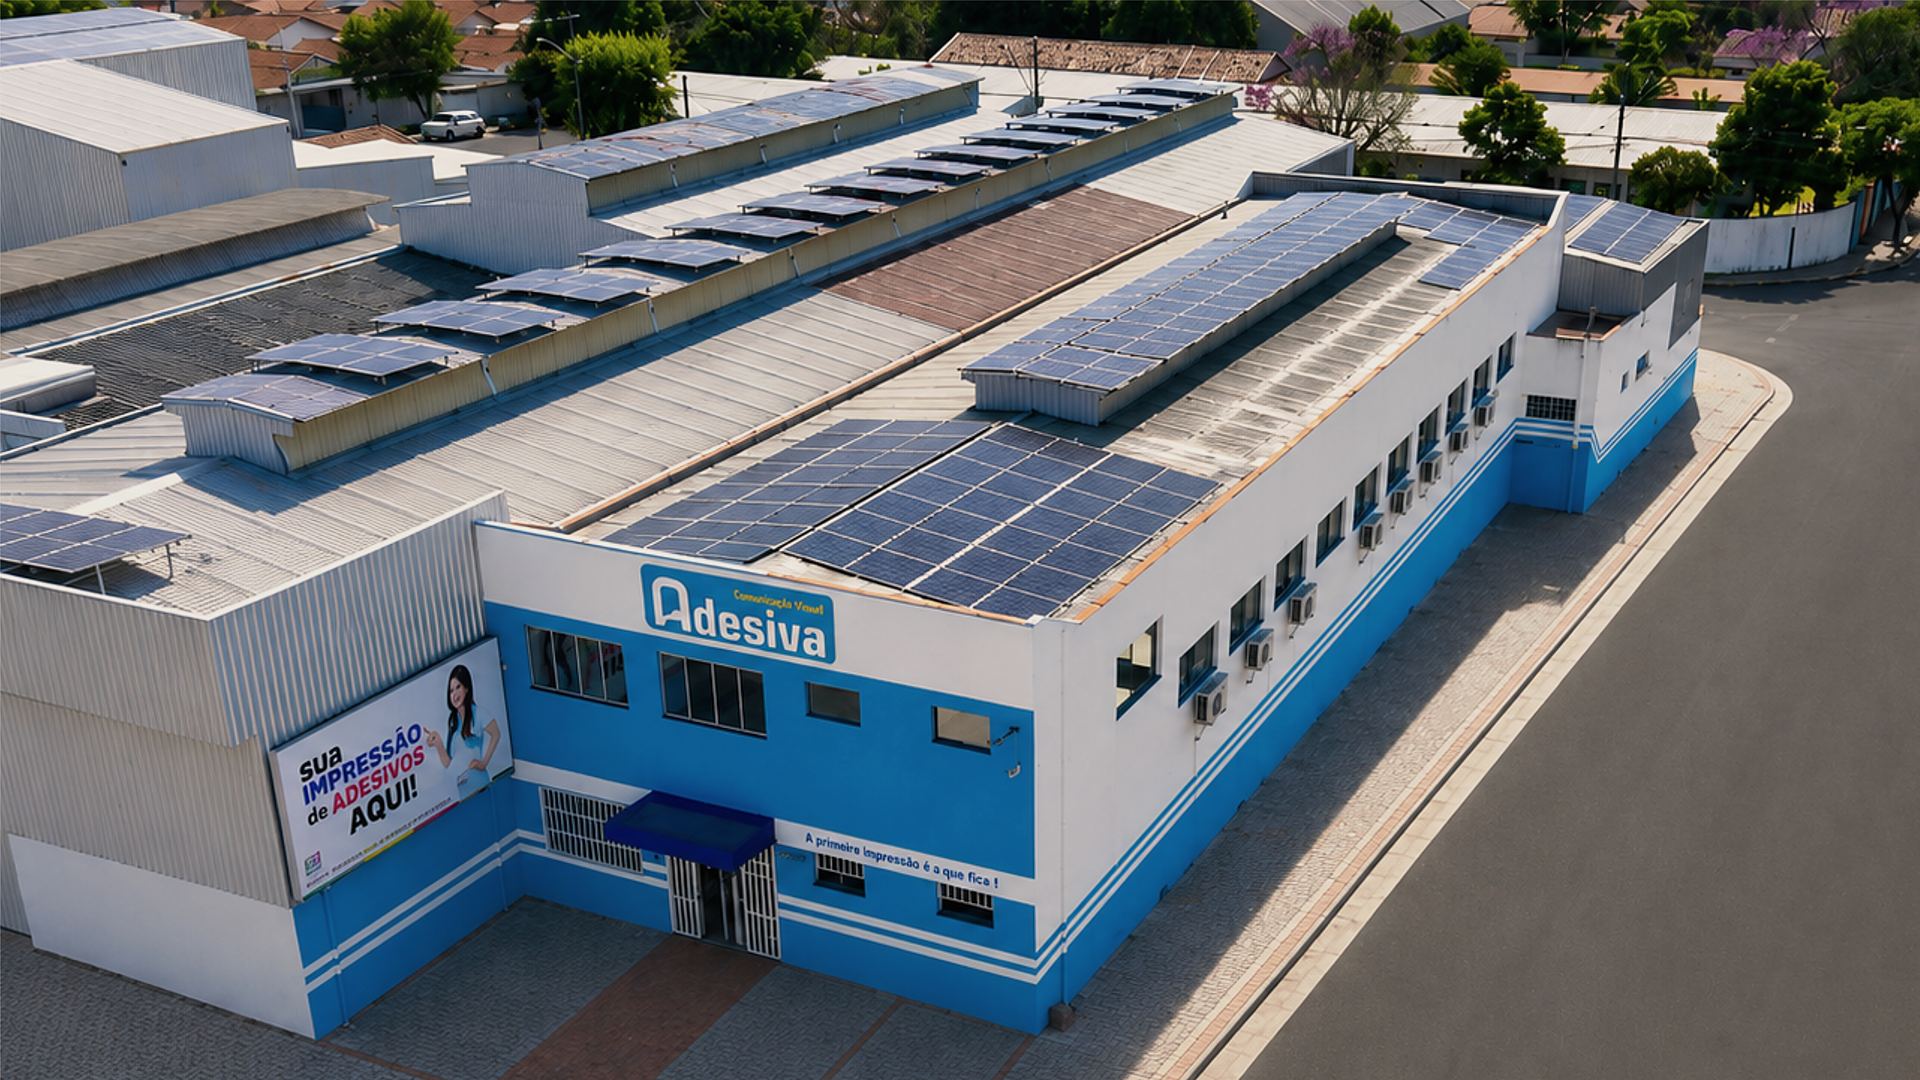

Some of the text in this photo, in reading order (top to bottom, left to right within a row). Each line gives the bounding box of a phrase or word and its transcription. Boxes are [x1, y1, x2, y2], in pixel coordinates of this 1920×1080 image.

[652, 576, 827, 658] Adesiva
[302, 723, 422, 805] IMPRESSÃO
[308, 745, 425, 826] de ADESIVOS
[350, 774, 418, 835] AQUI!
[805, 832, 814, 843] A
[816, 836, 860, 855] primeira
[863, 846, 920, 870] impressão
[923, 860, 931, 873] é
[933, 866, 940, 875] a
[942, 868, 965, 881] que
[968, 871, 991, 887] fica
